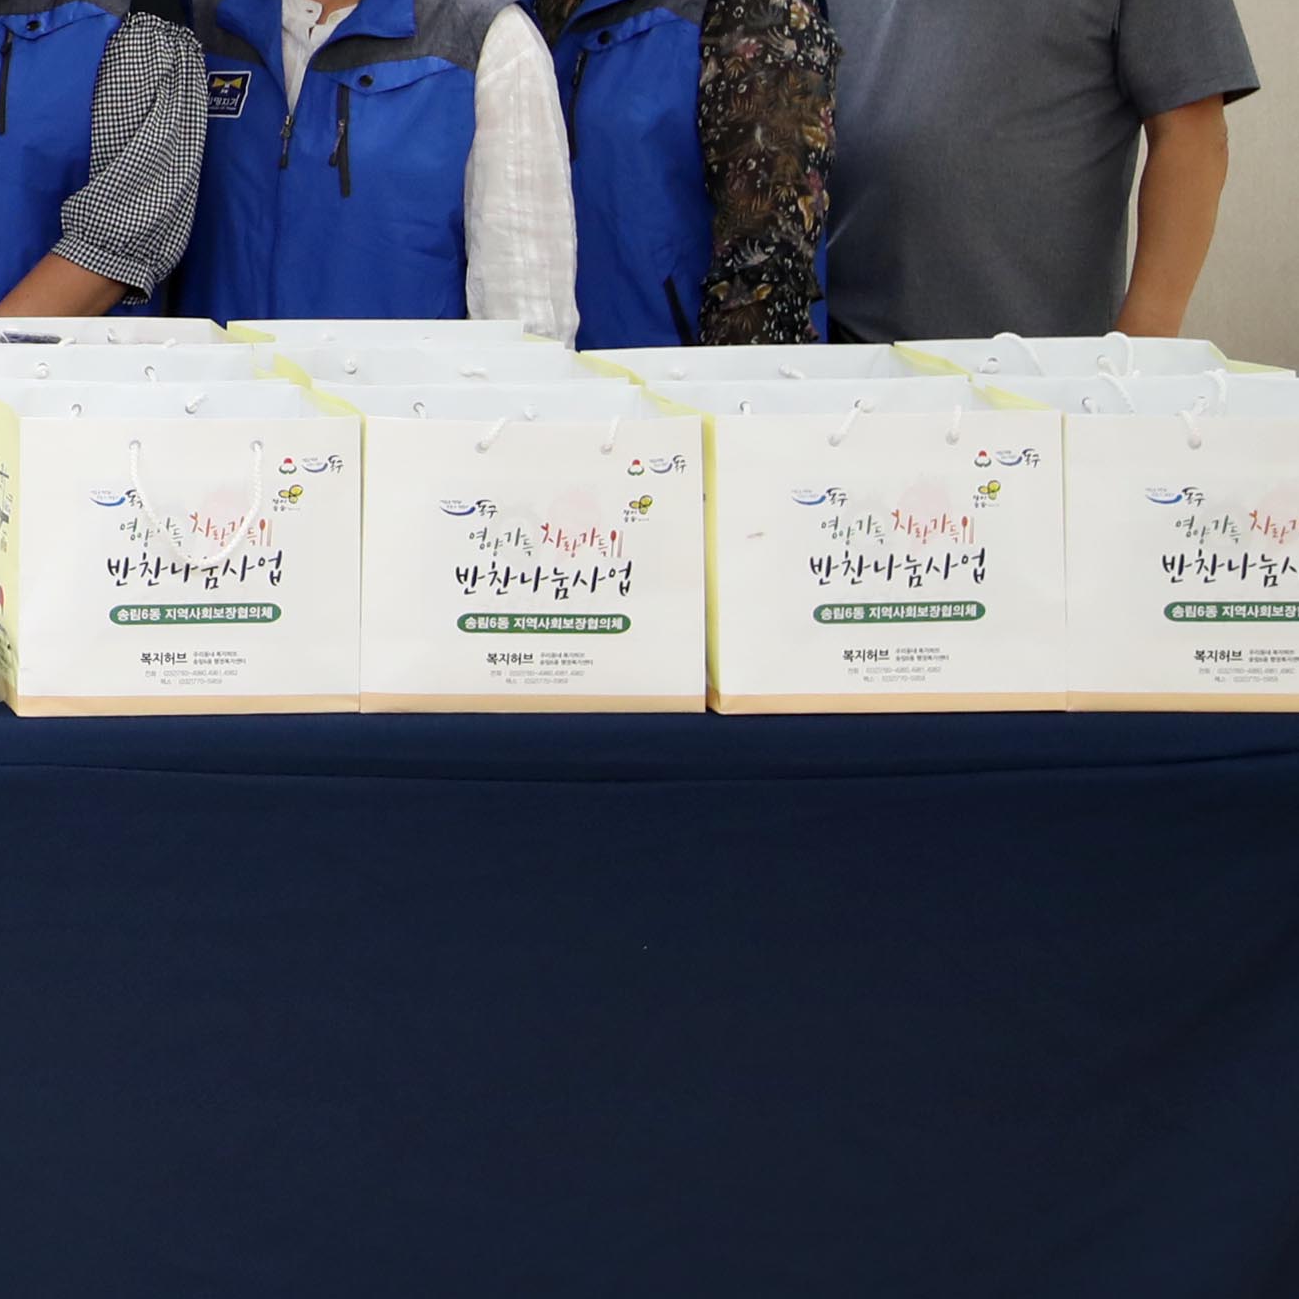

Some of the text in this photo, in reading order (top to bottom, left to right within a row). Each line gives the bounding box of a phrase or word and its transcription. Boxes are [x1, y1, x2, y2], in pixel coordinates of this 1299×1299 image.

[810, 548, 985, 588] 반찬나눔사업
[455, 561, 632, 600] 반찬나눔사업
[1222, 604, 1299, 619] 지역사회보장
[141, 651, 188, 666] 복지허브
[487, 652, 534, 666] 복지허브
[843, 649, 890, 663] 복지허브
[1194, 649, 1243, 663] 복지허브
